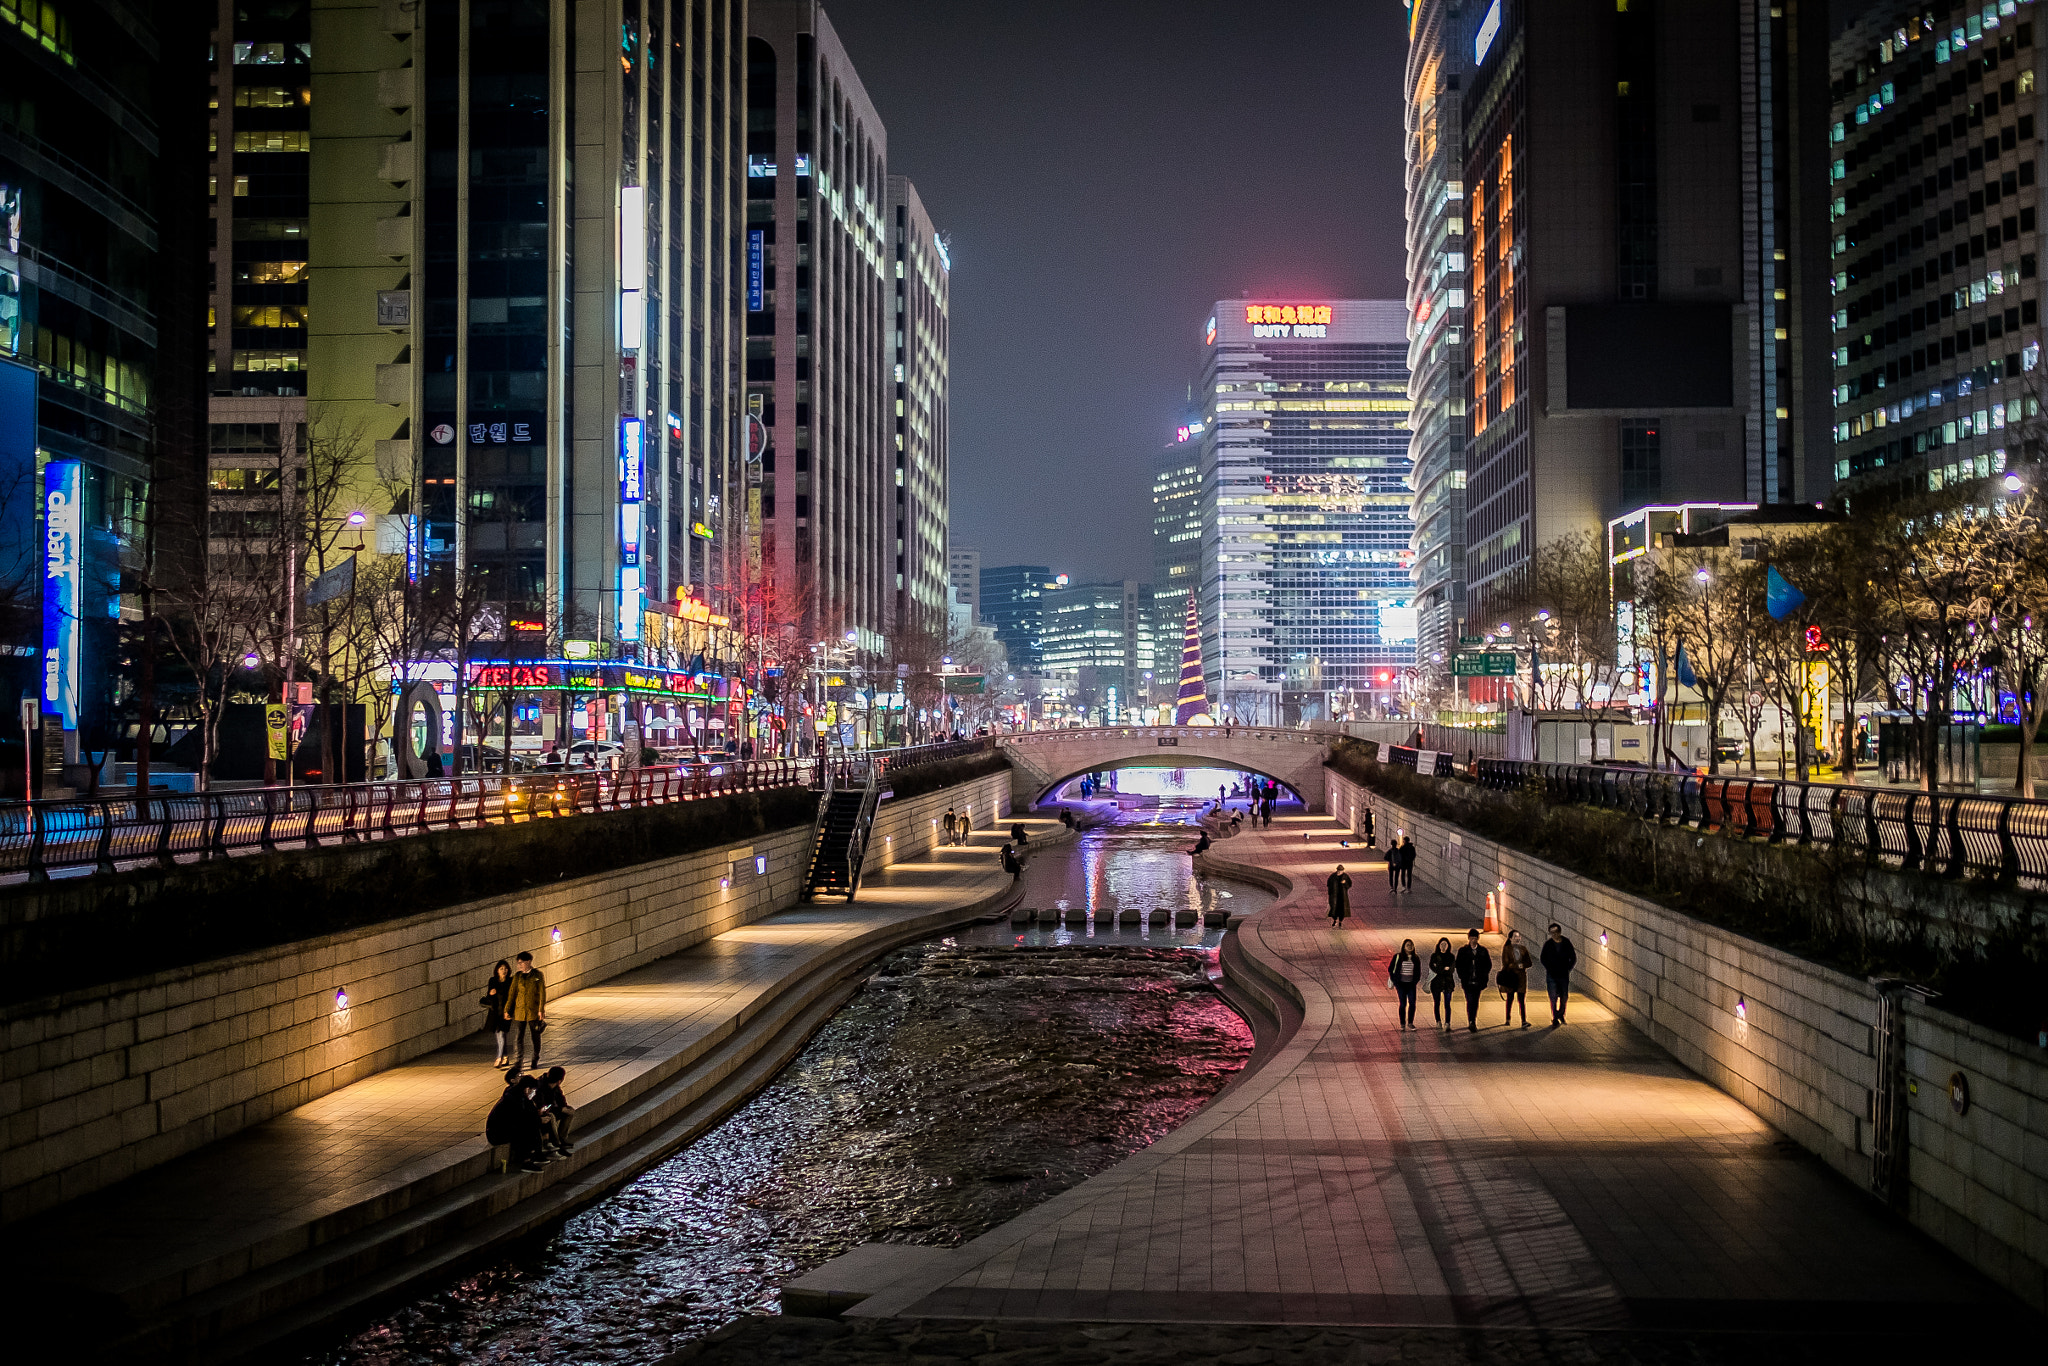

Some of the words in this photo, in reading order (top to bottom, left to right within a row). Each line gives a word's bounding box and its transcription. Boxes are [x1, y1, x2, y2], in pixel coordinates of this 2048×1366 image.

[1253, 324, 1290, 338] DUTY
[1293, 324, 1327, 338] FREE
[469, 423, 531, 444] 단월드
[479, 666, 549, 687] TEXAS
